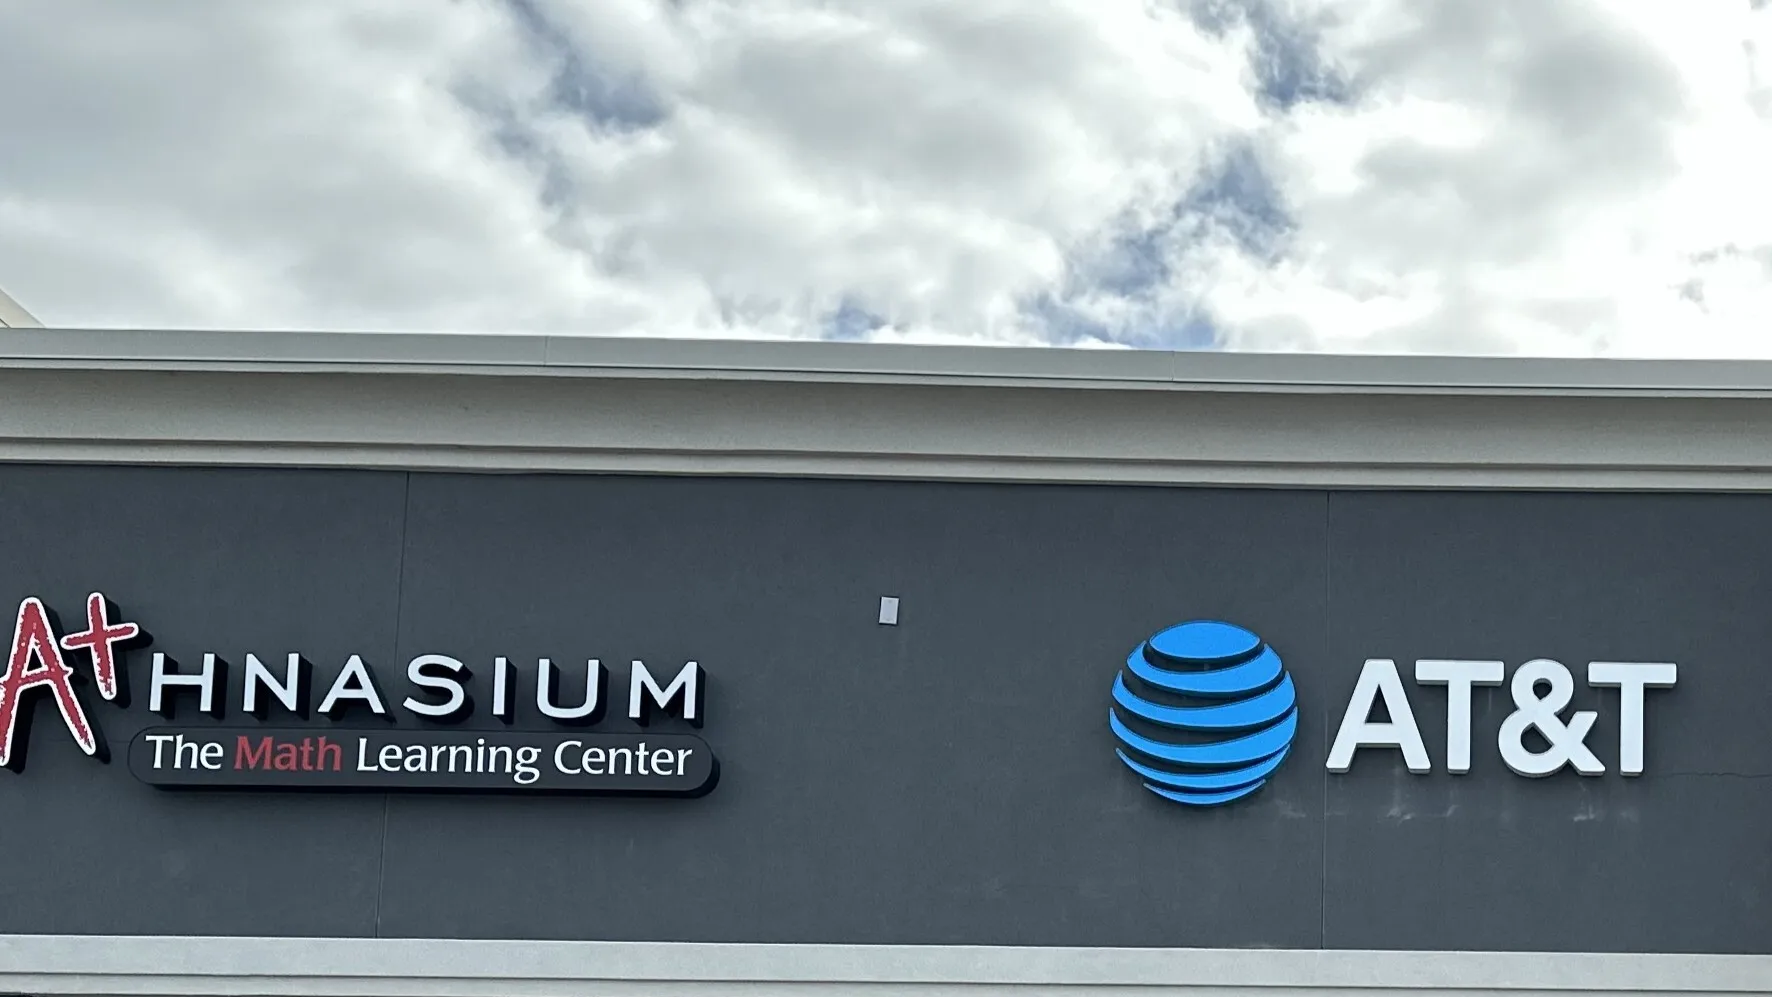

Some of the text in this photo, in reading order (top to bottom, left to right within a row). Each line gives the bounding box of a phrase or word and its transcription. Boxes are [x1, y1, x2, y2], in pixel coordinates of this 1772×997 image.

[145, 734, 693, 784] The Math Learning Center
[1325, 659, 1677, 777] AT&T
